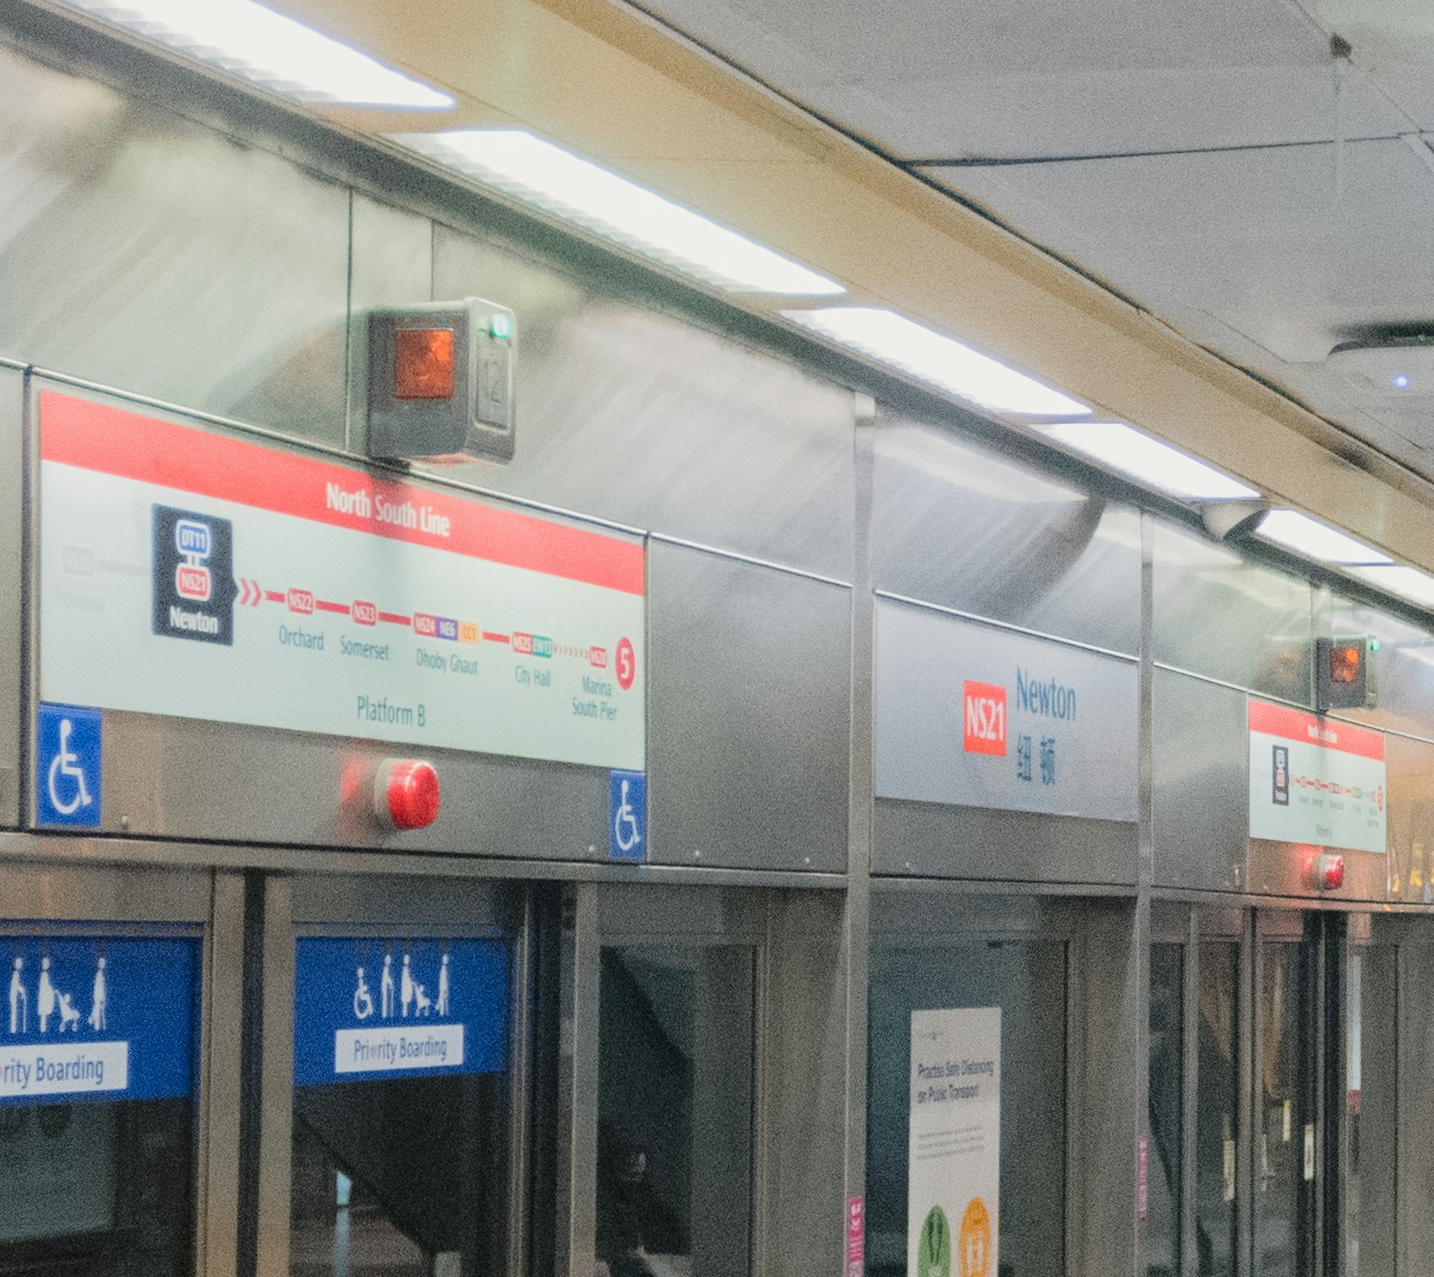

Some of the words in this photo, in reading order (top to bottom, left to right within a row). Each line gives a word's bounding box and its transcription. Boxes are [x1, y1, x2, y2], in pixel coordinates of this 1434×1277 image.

[326, 482, 371, 518] North
[375, 495, 417, 530] South
[420, 506, 450, 537] Line
[181, 529, 207, 550] DT11
[181, 571, 207, 591] NS21
[170, 605, 218, 635] Newton
[279, 625, 324, 650] Orchard
[340, 636, 389, 661] Somerset
[416, 648, 447, 673] Dhoby
[450, 654, 478, 675] Ghaut
[619, 645, 630, 679] 5
[515, 665, 531, 686] City
[533, 668, 551, 687] Hall
[582, 675, 612, 697] Marina
[1016, 665, 1076, 721] Newton
[357, 695, 413, 725] Platform
[417, 704, 426, 727] B
[572, 698, 597, 717] South
[600, 704, 618, 721] Pier
[966, 695, 1004, 741] NS21
[353, 1038, 398, 1065] Priority
[399, 1035, 447, 1062] Boarding
[35, 1055, 104, 1085] Boarding
